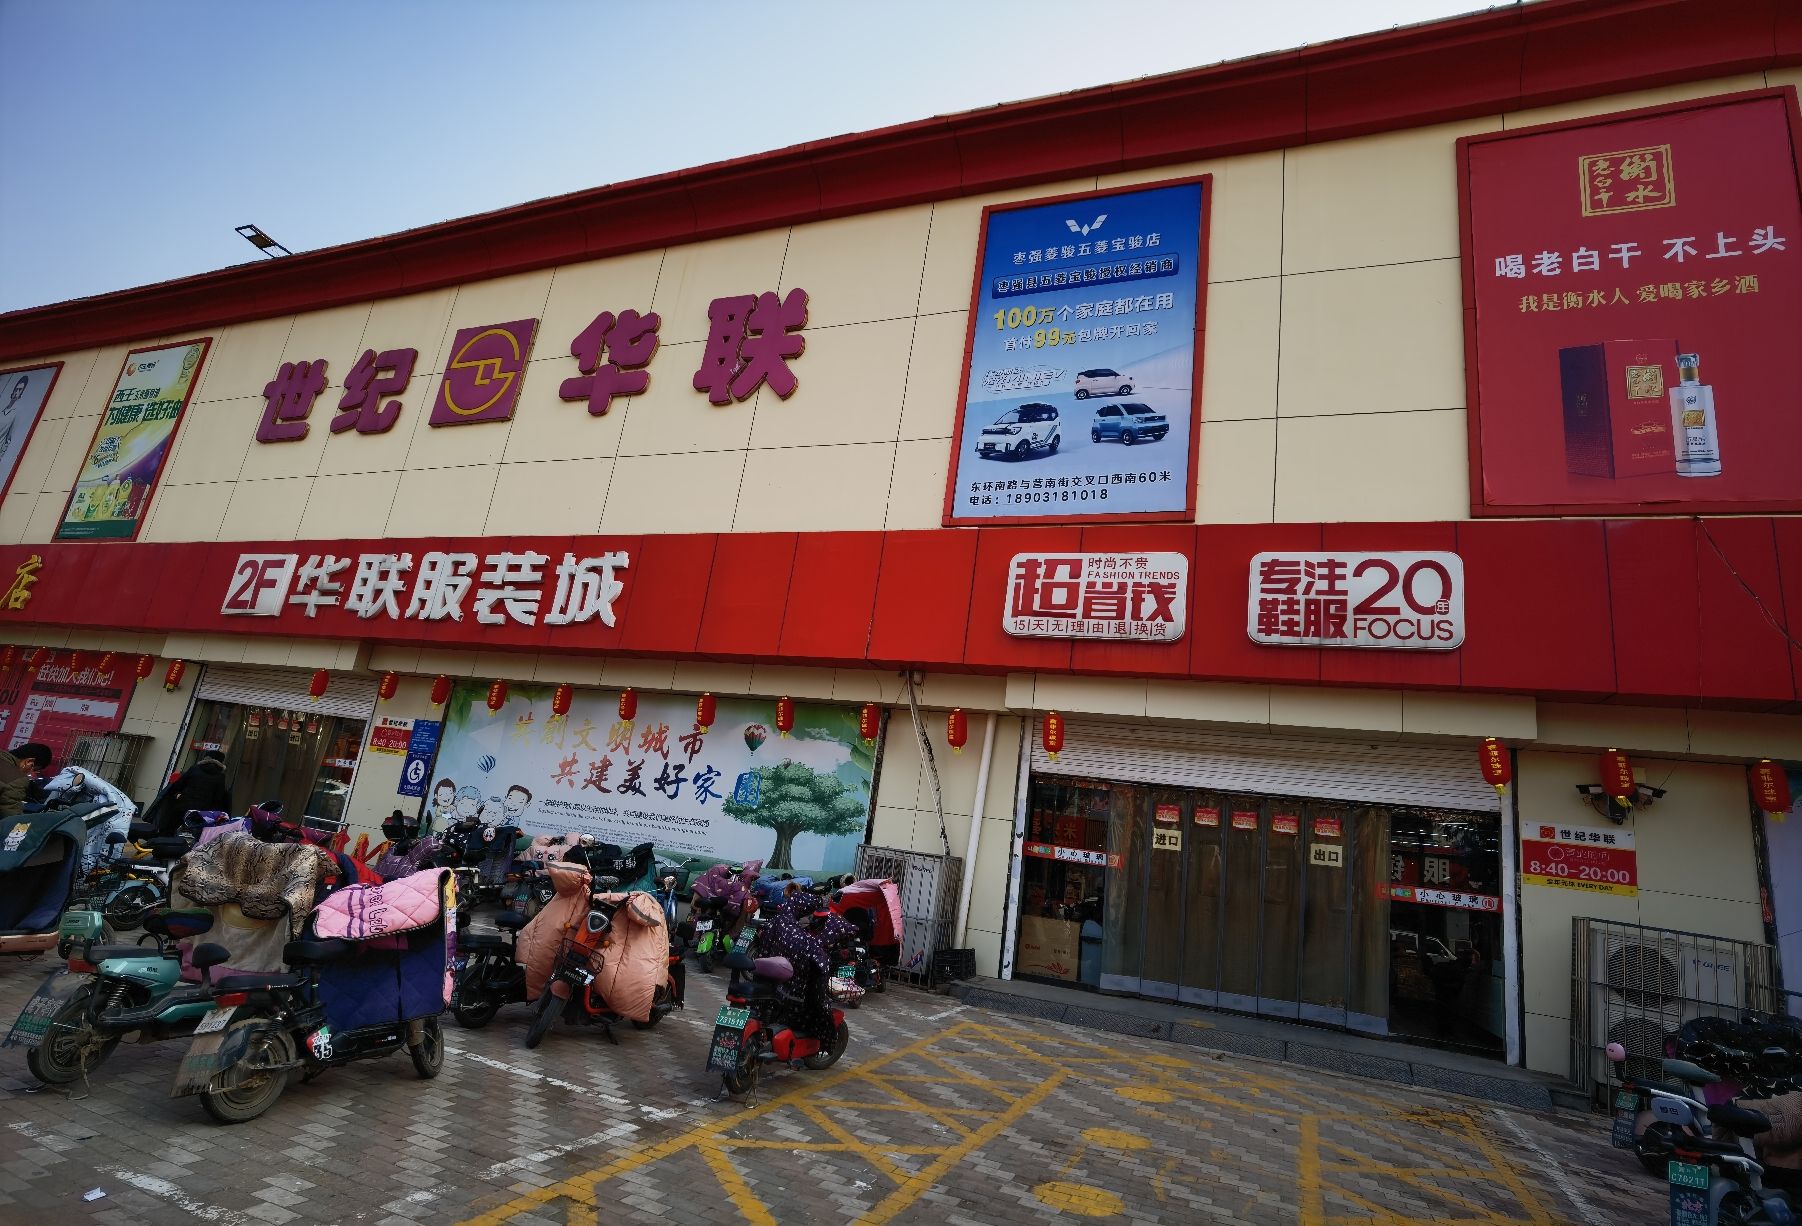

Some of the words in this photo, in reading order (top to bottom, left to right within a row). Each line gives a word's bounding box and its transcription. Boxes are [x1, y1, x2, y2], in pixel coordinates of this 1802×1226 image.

[1495, 243, 1642, 279] 喝老白干
[1663, 226, 1786, 263] 不上头
[1519, 289, 1631, 314] 我是衡水人
[1638, 274, 1760, 303] 爱喝家乡酒
[994, 292, 1174, 330] 100万个家庭都在用
[256, 347, 418, 444] 世纪
[558, 287, 808, 417] 华联
[971, 471, 1172, 493] 东环南路与营南街交叉口西南60米
[1087, 557, 1149, 570] 时尚不贵
[1087, 571, 1135, 580] FASHION
[1138, 571, 1180, 580] TRENDS
[225, 559, 287, 610] 2F
[289, 551, 629, 627] 华联服装城
[1260, 558, 1349, 596] 专注
[1010, 558, 1177, 622] 超省钱
[1257, 597, 1349, 639] 鞋服
[1353, 617, 1454, 641] FOCUS
[1154, 833, 1179, 846] 进口
[1560, 829, 1616, 845] 世纪华联
[1313, 849, 1340, 863] 出口
[1529, 860, 1630, 884] 8:40-20:00
[1419, 889, 1480, 905] 小心玻璃
